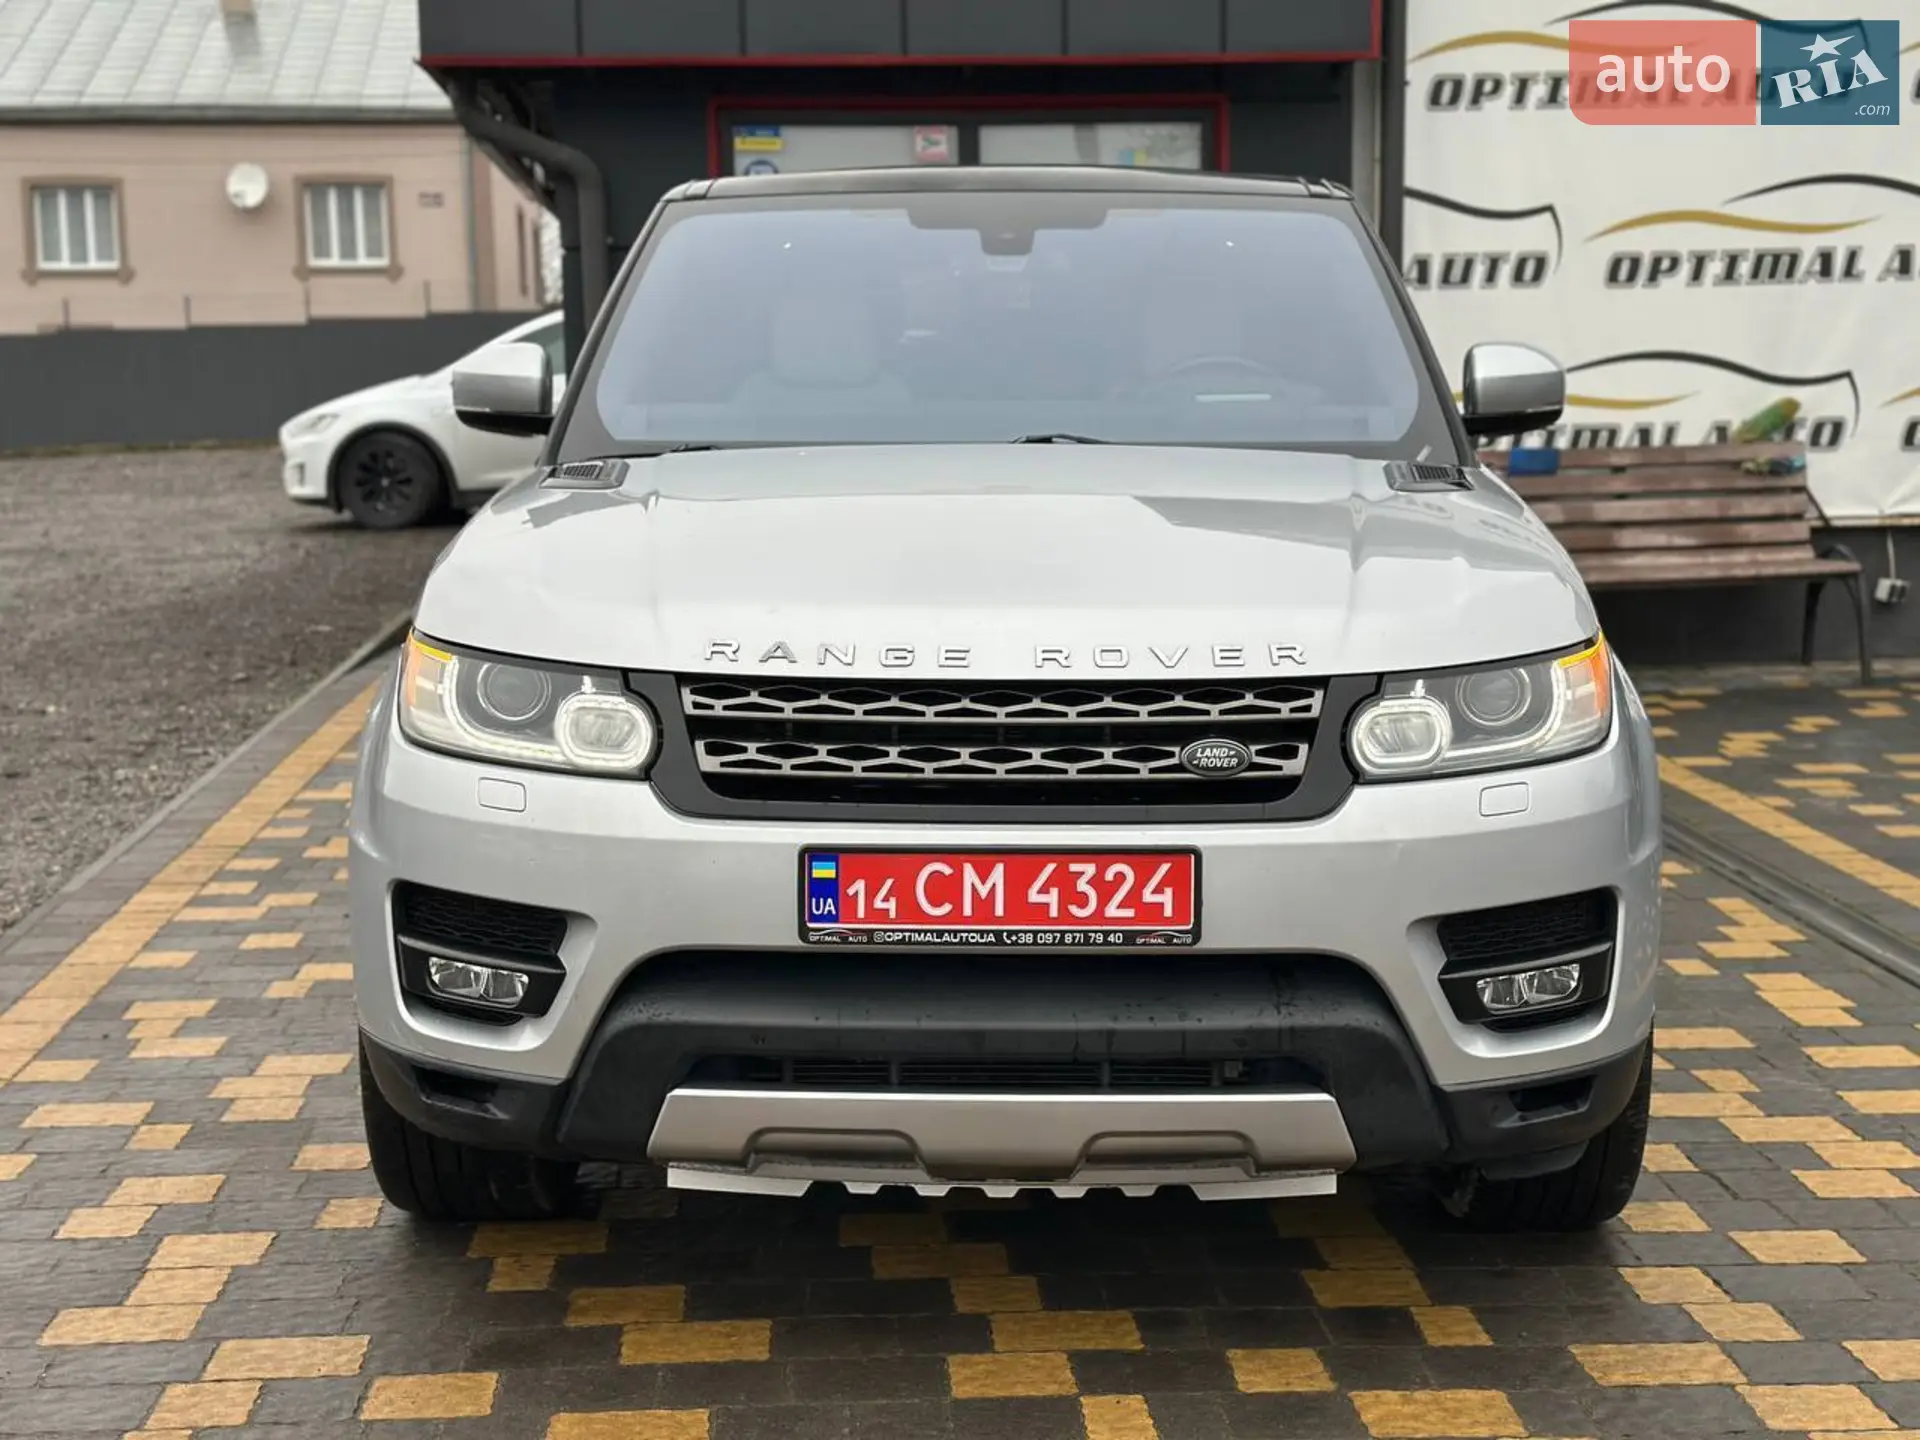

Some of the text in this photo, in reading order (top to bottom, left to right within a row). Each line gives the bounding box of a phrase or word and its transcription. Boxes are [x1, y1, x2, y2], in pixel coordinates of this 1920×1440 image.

[1402, 252, 1550, 291] AUTO
[1605, 246, 1864, 289] OPTIMAL
[704, 638, 1307, 669] RANGE ROVER
[1196, 747, 1229, 757] LAND
[1199, 758, 1238, 768] ROVER
[846, 862, 1174, 919] 14 CM 4324
[811, 897, 836, 916] UA
[848, 935, 868, 943] AUTO
[1037, 932, 1060, 944] 097
[1064, 932, 1084, 944] 871
[1088, 932, 1103, 944] 79
[1107, 932, 1123, 944] 40
